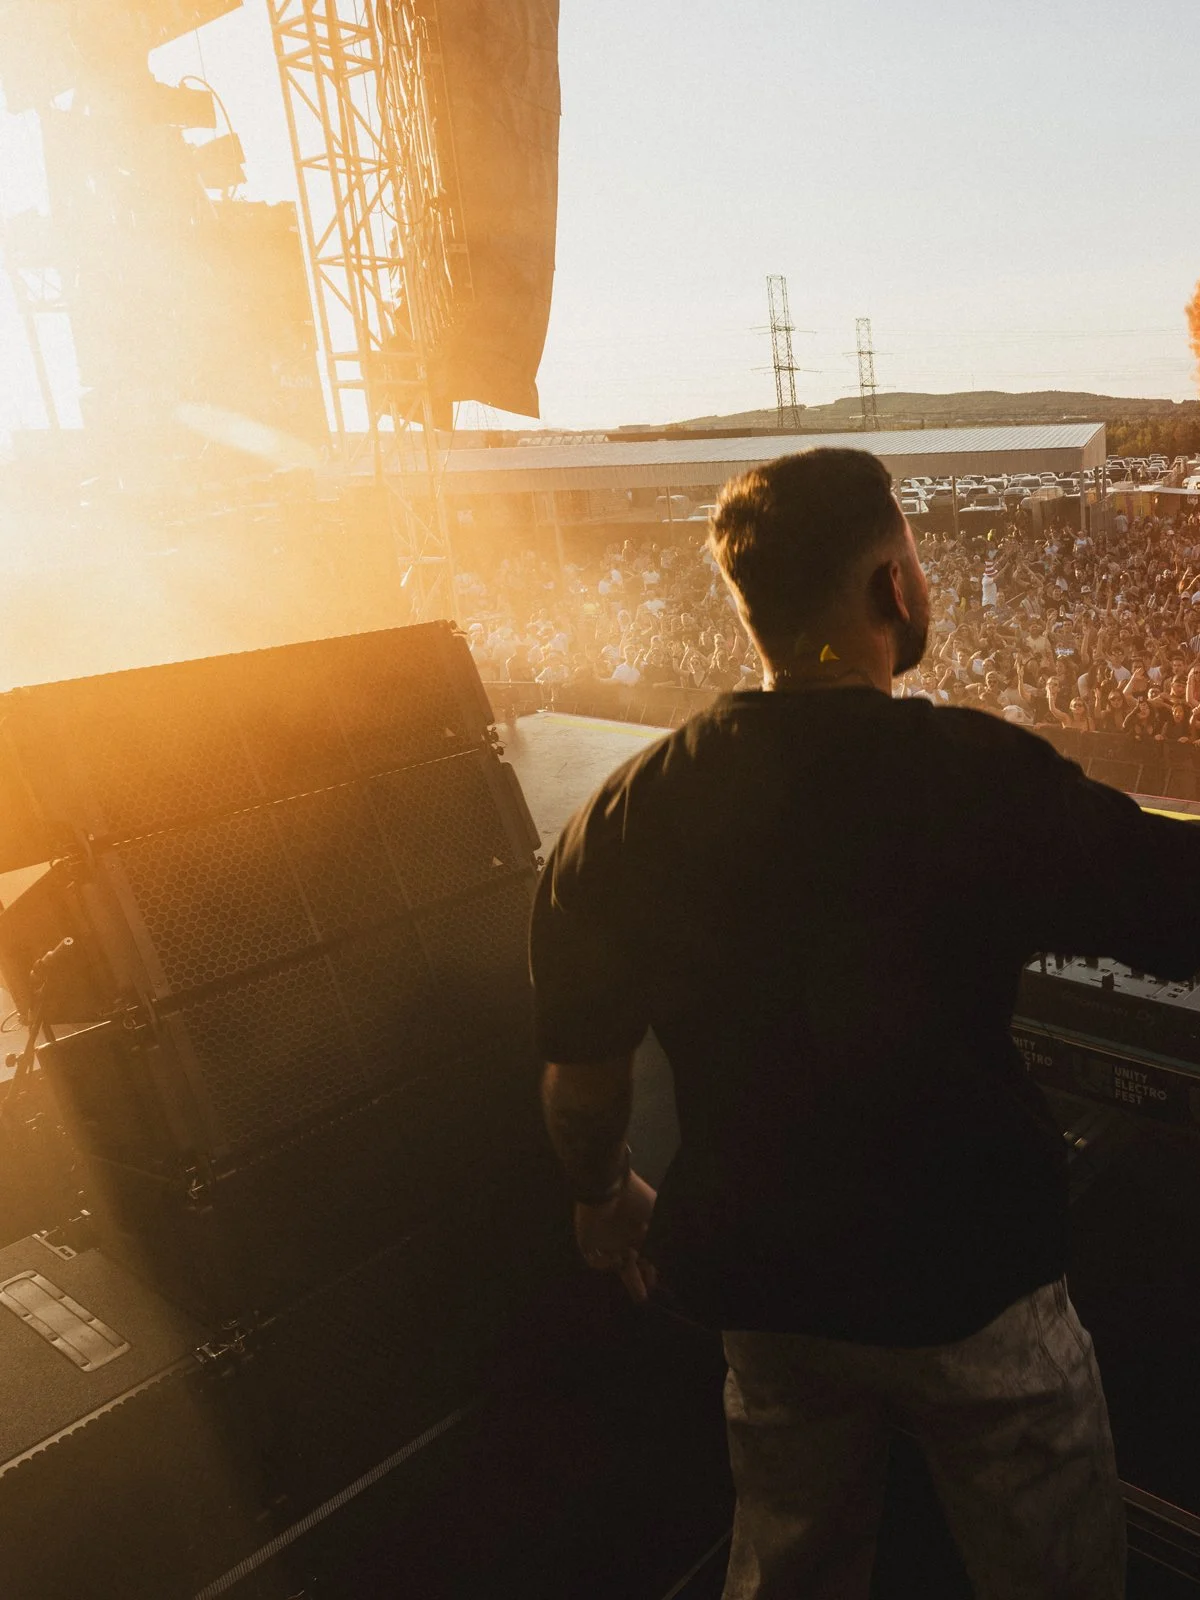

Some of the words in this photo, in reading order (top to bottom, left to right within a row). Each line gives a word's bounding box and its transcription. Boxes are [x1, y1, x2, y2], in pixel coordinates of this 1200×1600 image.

[1114, 1066, 1148, 1084] UNITY
[1114, 1077, 1167, 1101] ELECTRO
[1114, 1089, 1142, 1104] FEST
